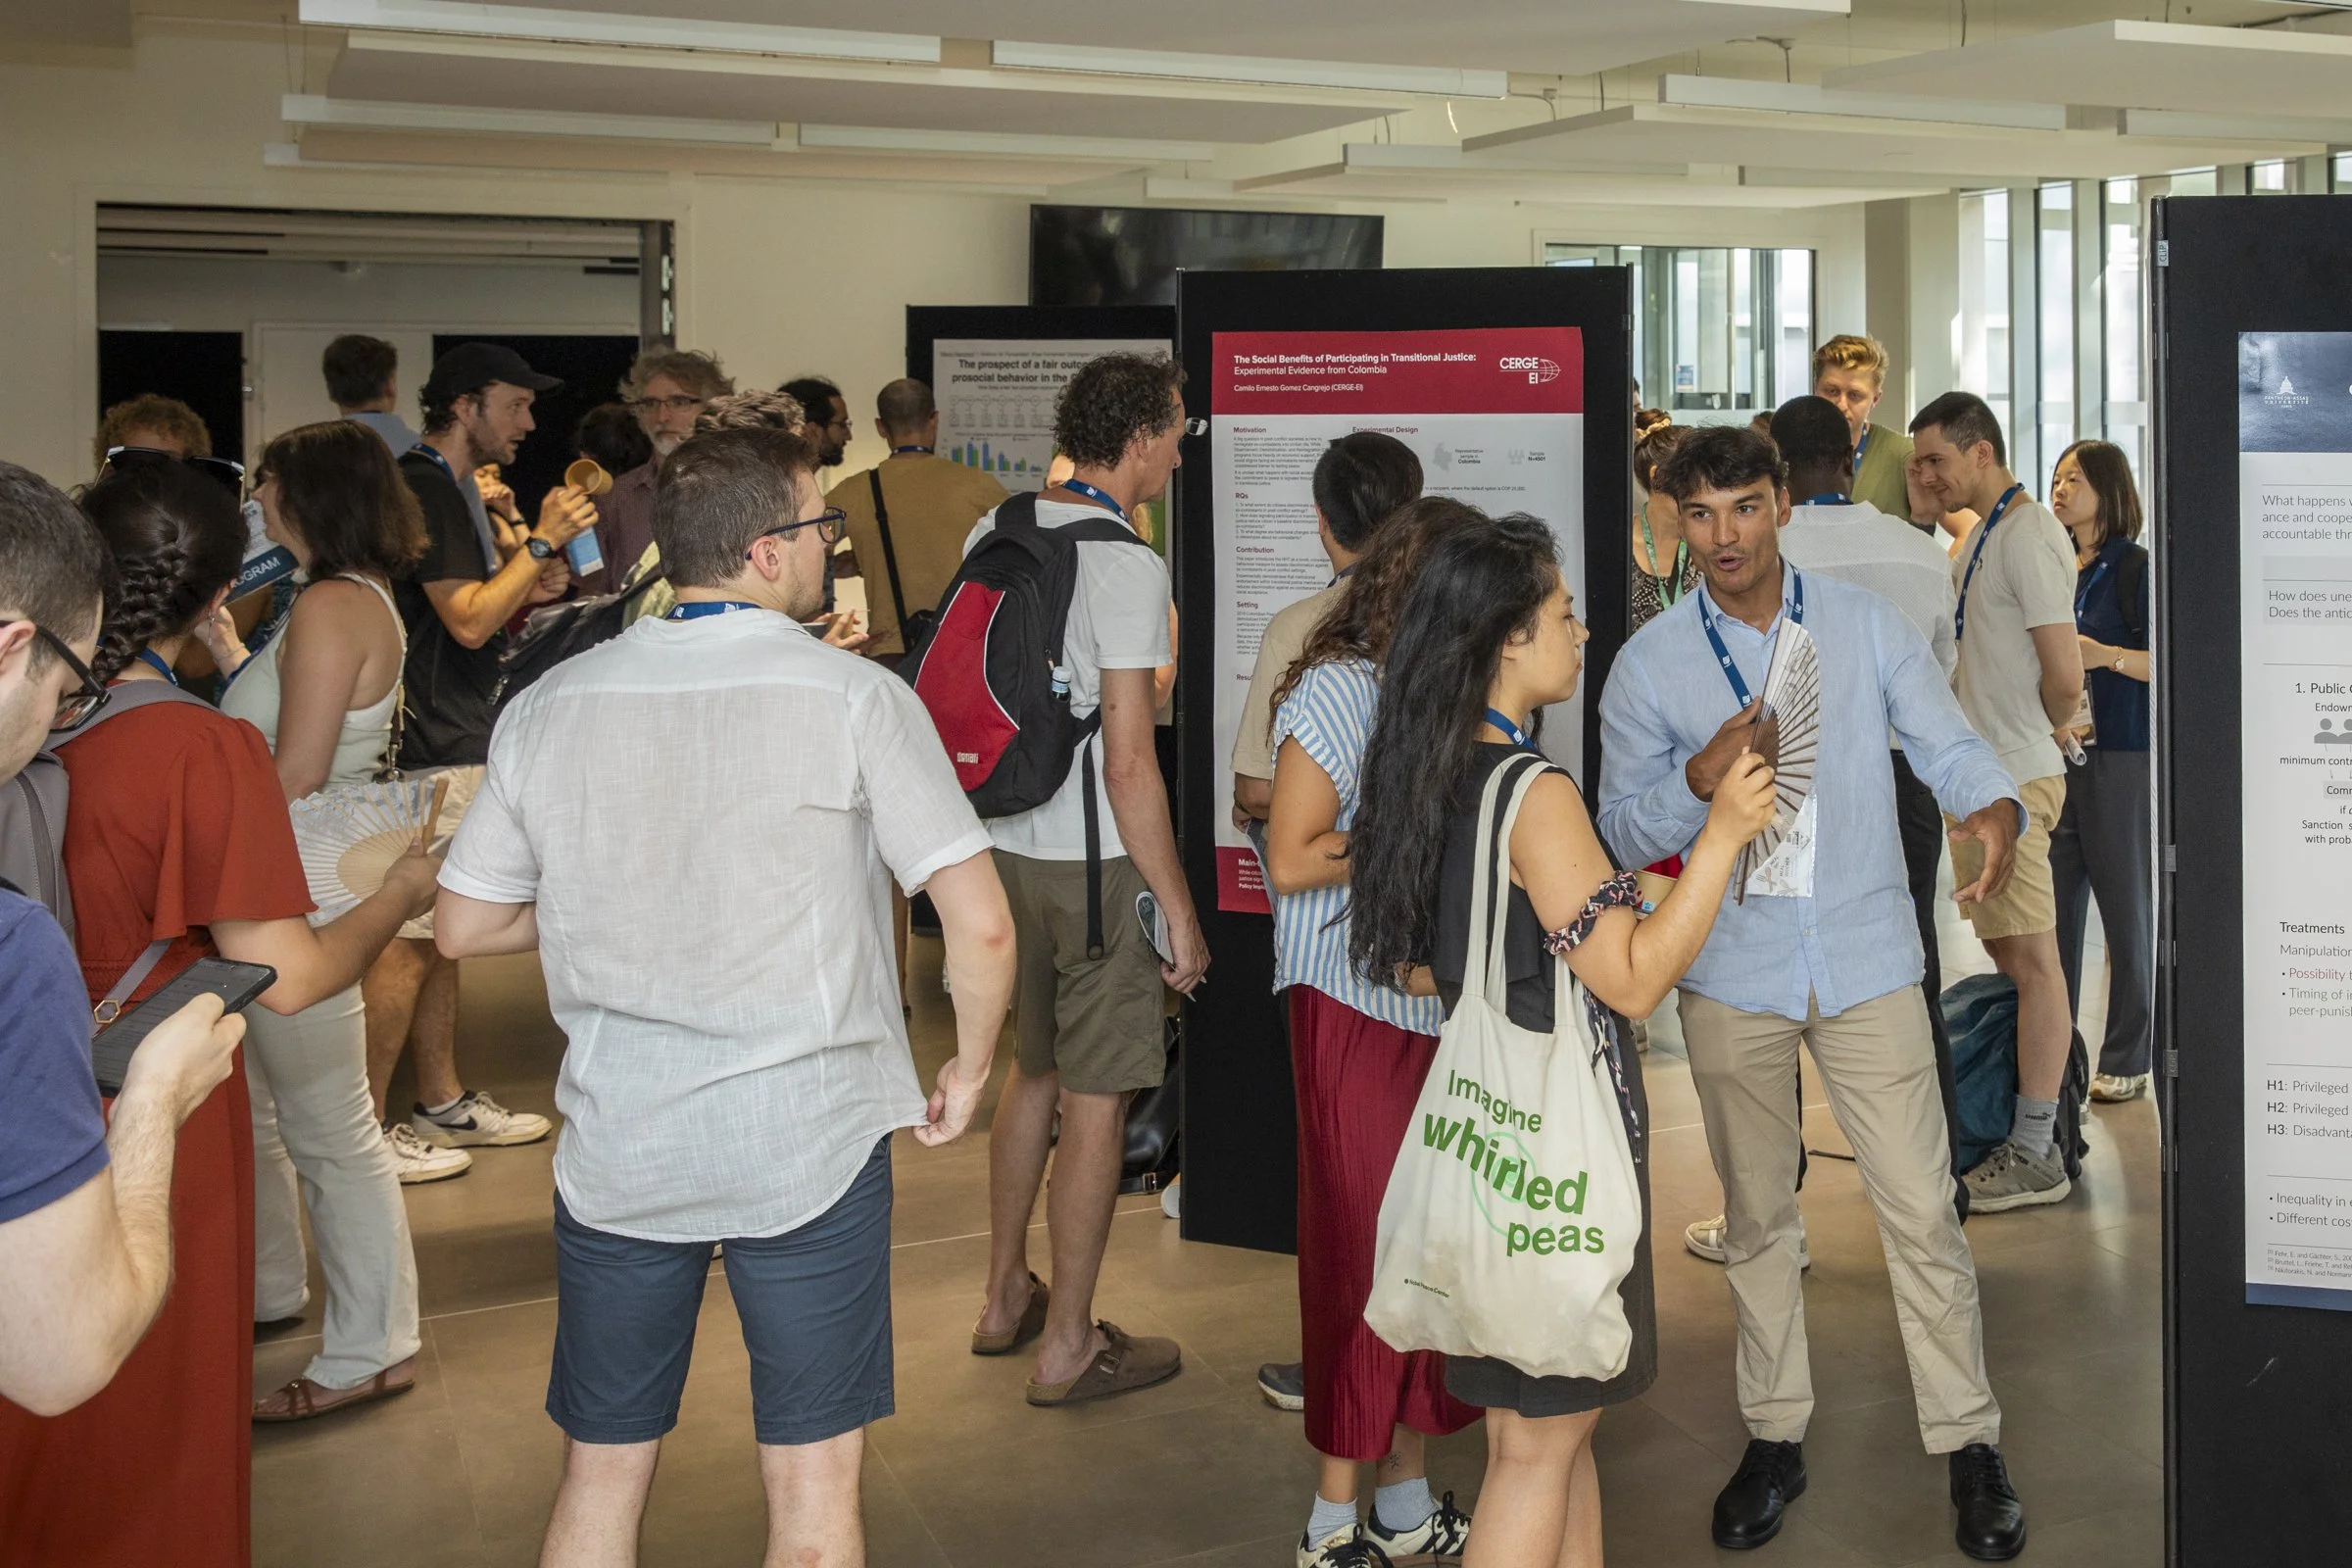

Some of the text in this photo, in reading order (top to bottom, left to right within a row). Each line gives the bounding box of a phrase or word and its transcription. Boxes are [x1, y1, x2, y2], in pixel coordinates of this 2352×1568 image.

[1234, 352, 1477, 364] The Social Benefits of Participating in Transitional Justice:
[1499, 357, 1539, 369] CERGE
[958, 359, 976, 369] The
[978, 360, 1019, 371] prospect
[1021, 359, 1032, 369] of
[1042, 359, 1058, 369] fair
[1234, 365, 1387, 376] Experimental Evidence from Colombia
[952, 373, 995, 385] prosocial
[997, 372, 1039, 383] behavior
[1041, 373, 1051, 383] in
[1052, 372, 1068, 383] the
[1529, 372, 1539, 384] EI
[1302, 384, 1330, 392] Cangrejo
[1331, 383, 1364, 392] (CERGE-EI)
[2262, 495, 2295, 506] What
[2297, 495, 2346, 509] happens
[2262, 514, 2289, 522] ance
[2293, 512, 2314, 522] and
[2262, 528, 2332, 539] accountable
[234, 557, 281, 586] OGRAM
[2269, 590, 2352, 602] How does une
[2269, 607, 2299, 618] Does
[2303, 608, 2321, 618] the
[2295, 683, 2305, 694] 1.
[2310, 683, 2346, 694] Public
[2279, 756, 2326, 765] minimum
[2340, 806, 2347, 814] if
[2302, 820, 2343, 830] Sanction
[2305, 835, 2326, 845] with
[2279, 921, 2345, 934] Treatments
[2289, 967, 2346, 982] Possibility
[2289, 987, 2328, 1002] Timing
[2331, 989, 2344, 1000] of
[2289, 1006, 2352, 1018] peer-punis
[2267, 1079, 2349, 1095] H1: Privileged
[1447, 1069, 1543, 1134] Imagine
[2267, 1102, 2349, 1118] H2: Privileged
[2267, 1124, 2288, 1135] H3:
[1423, 1112, 1589, 1216] whirled
[2277, 1193, 2332, 1208] Inequality
[2335, 1196, 2346, 1207] in
[2277, 1212, 2352, 1227] Different cos
[1506, 1222, 1605, 1257] peas
